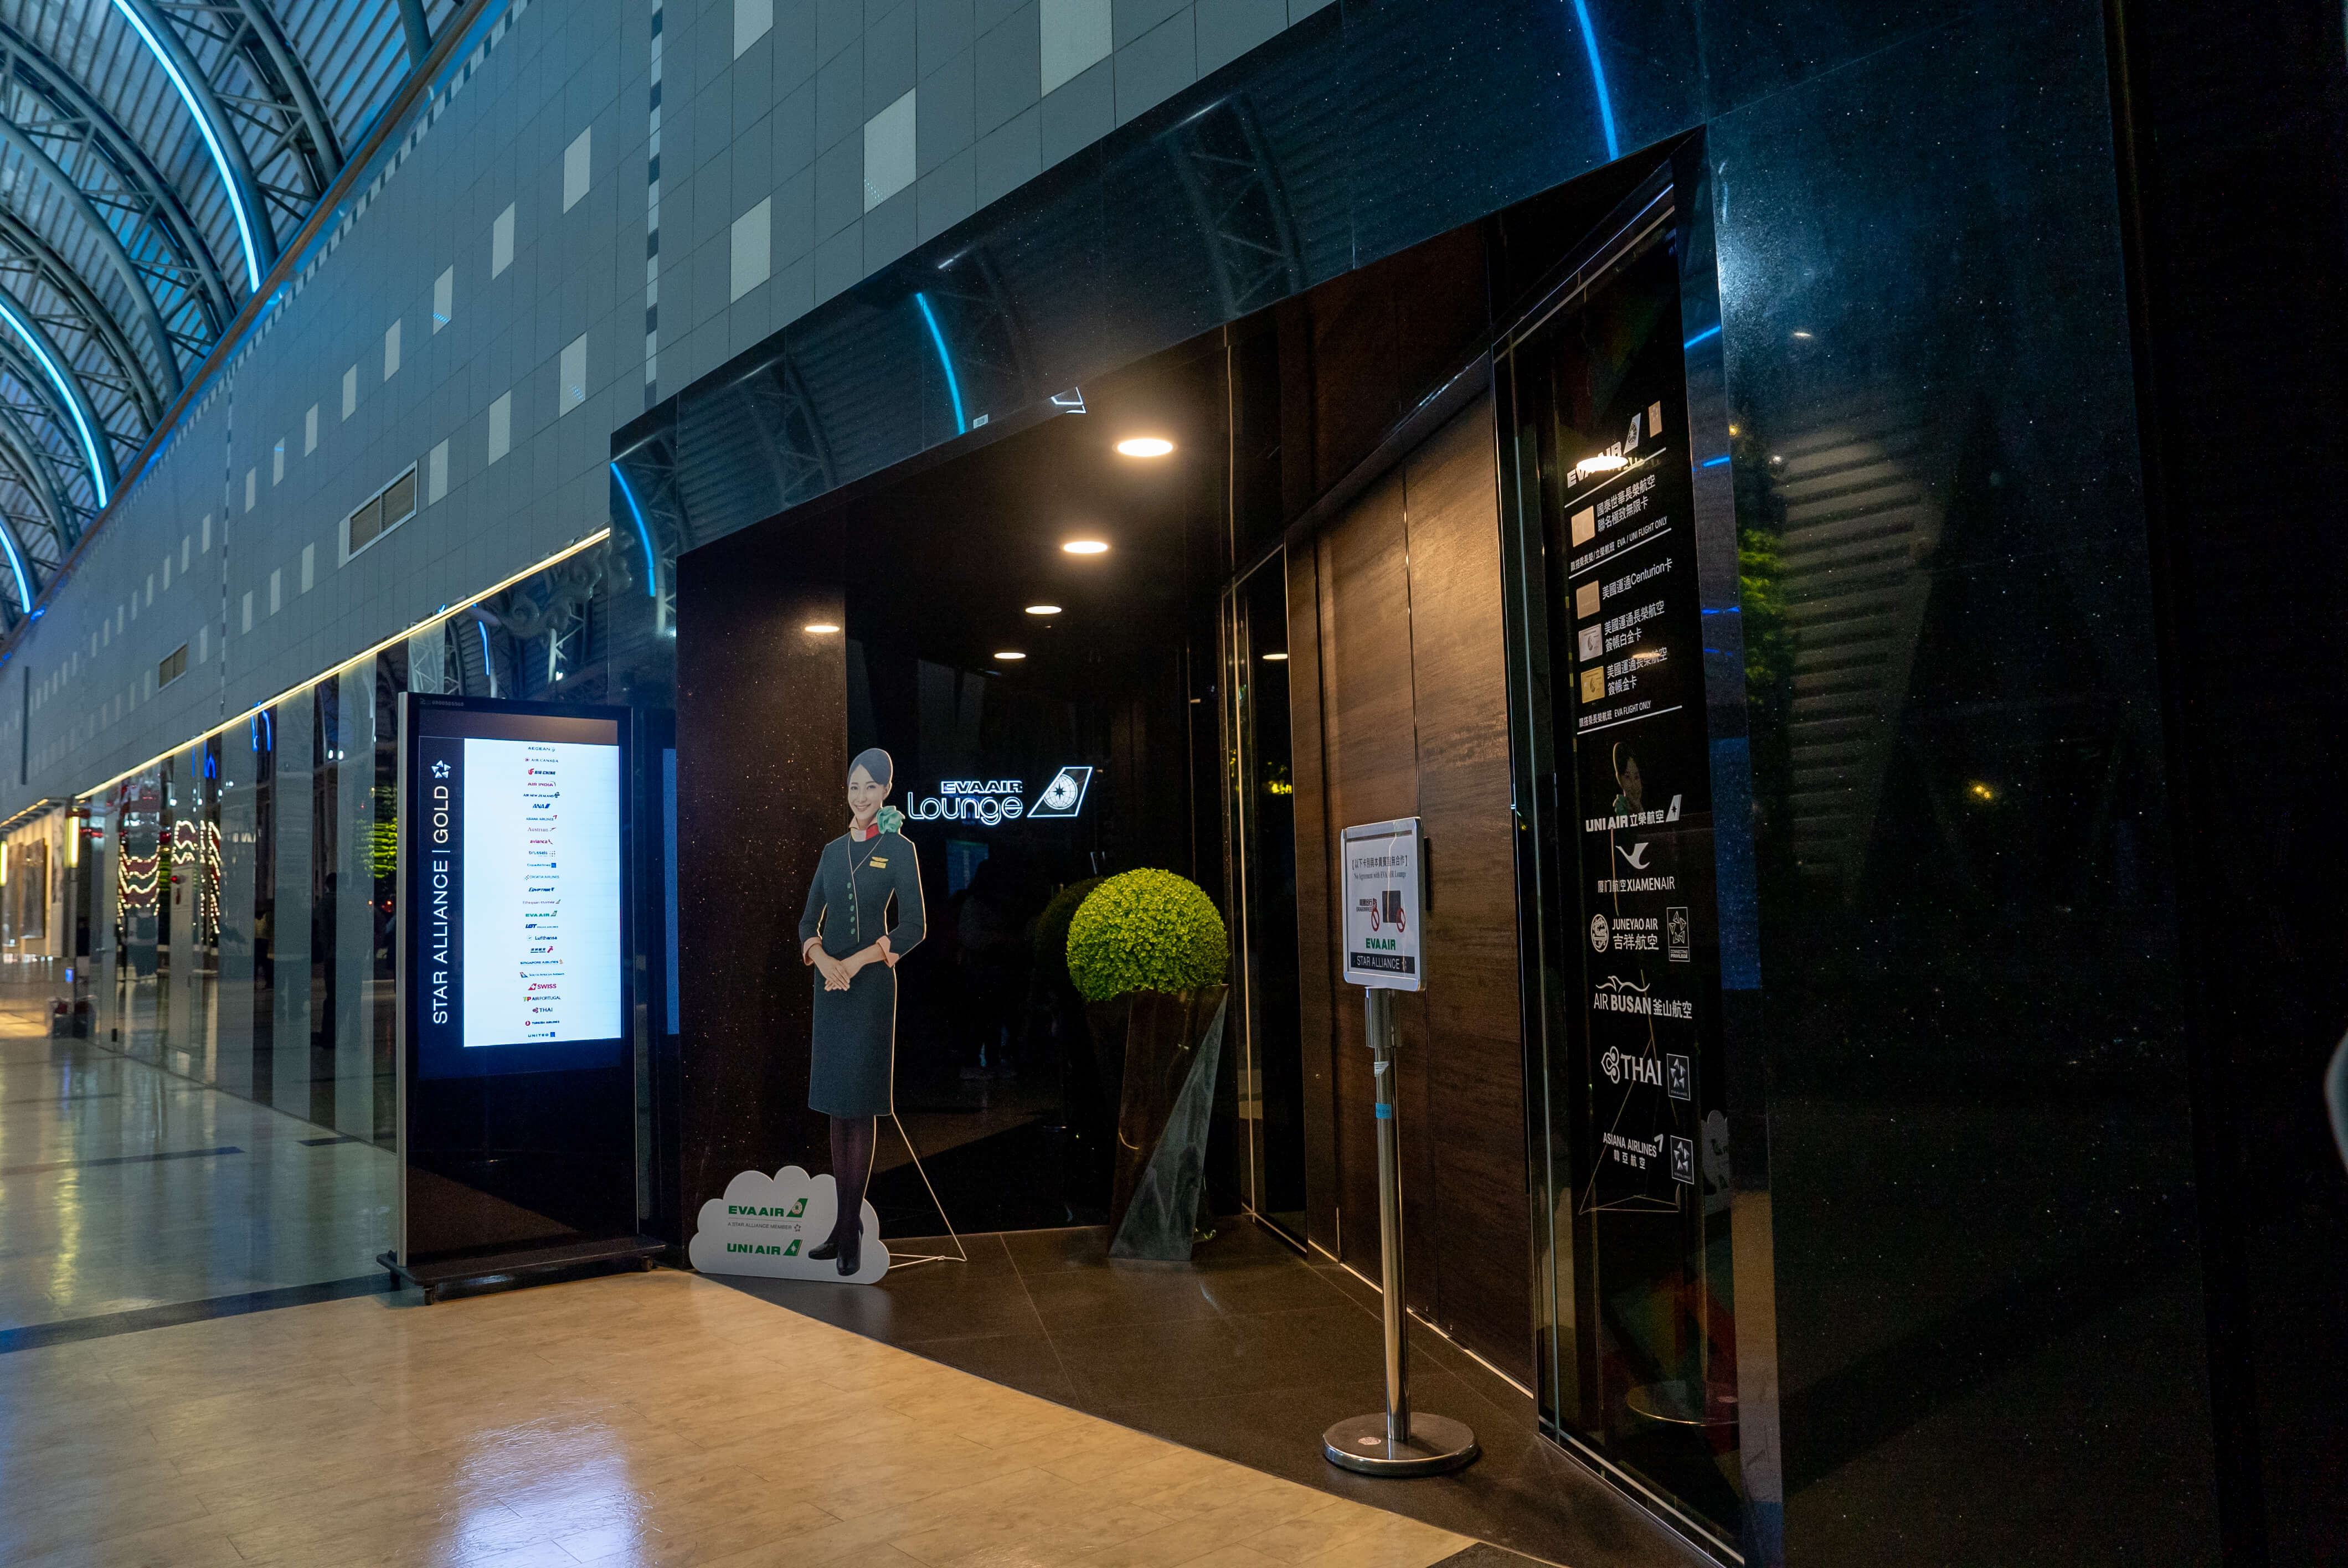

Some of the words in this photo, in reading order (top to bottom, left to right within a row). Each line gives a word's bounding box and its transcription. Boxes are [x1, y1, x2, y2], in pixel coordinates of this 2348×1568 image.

[1597, 474, 1656, 518] 國泰世華長榮航空
[1597, 495, 1649, 533] 聯名極致無限卡
[1617, 538, 1626, 548] EVA
[1629, 532, 1638, 541] UNI
[1638, 522, 1654, 538] FLIGHT
[1655, 515, 1668, 529] ONLY
[1604, 600, 1665, 636] 美國運通長榮航空
[1605, 627, 1642, 653] 簽帳白金卡
[1608, 674, 1638, 696] 簽帳金卡
[1614, 709, 1623, 718] EVA
[1623, 703, 1639, 716] FLIGHT
[1639, 700, 1651, 711] ONLY
[433, 785, 449, 844] GOLD
[908, 792, 1023, 826] Lounge
[1630, 809, 1665, 827] 立榮航空
[433, 860, 448, 964] ALLIANCE
[1612, 918, 1644, 930] JUNEYAO
[1645, 918, 1659, 930] AIR
[1613, 933, 1660, 951] 吉祥航空
[1357, 955, 1371, 966] STAR
[1372, 957, 1400, 969] ALLIANCE
[433, 971, 448, 1024] STAR
[1594, 993, 1609, 1010] AIR
[1610, 994, 1652, 1015] BUSAN
[1652, 998, 1692, 1019] 釜山航空
[1620, 1053, 1662, 1086] THAI
[1603, 1132, 1626, 1149] ASIANA
[1627, 1138, 1657, 1158] AIRLINES
